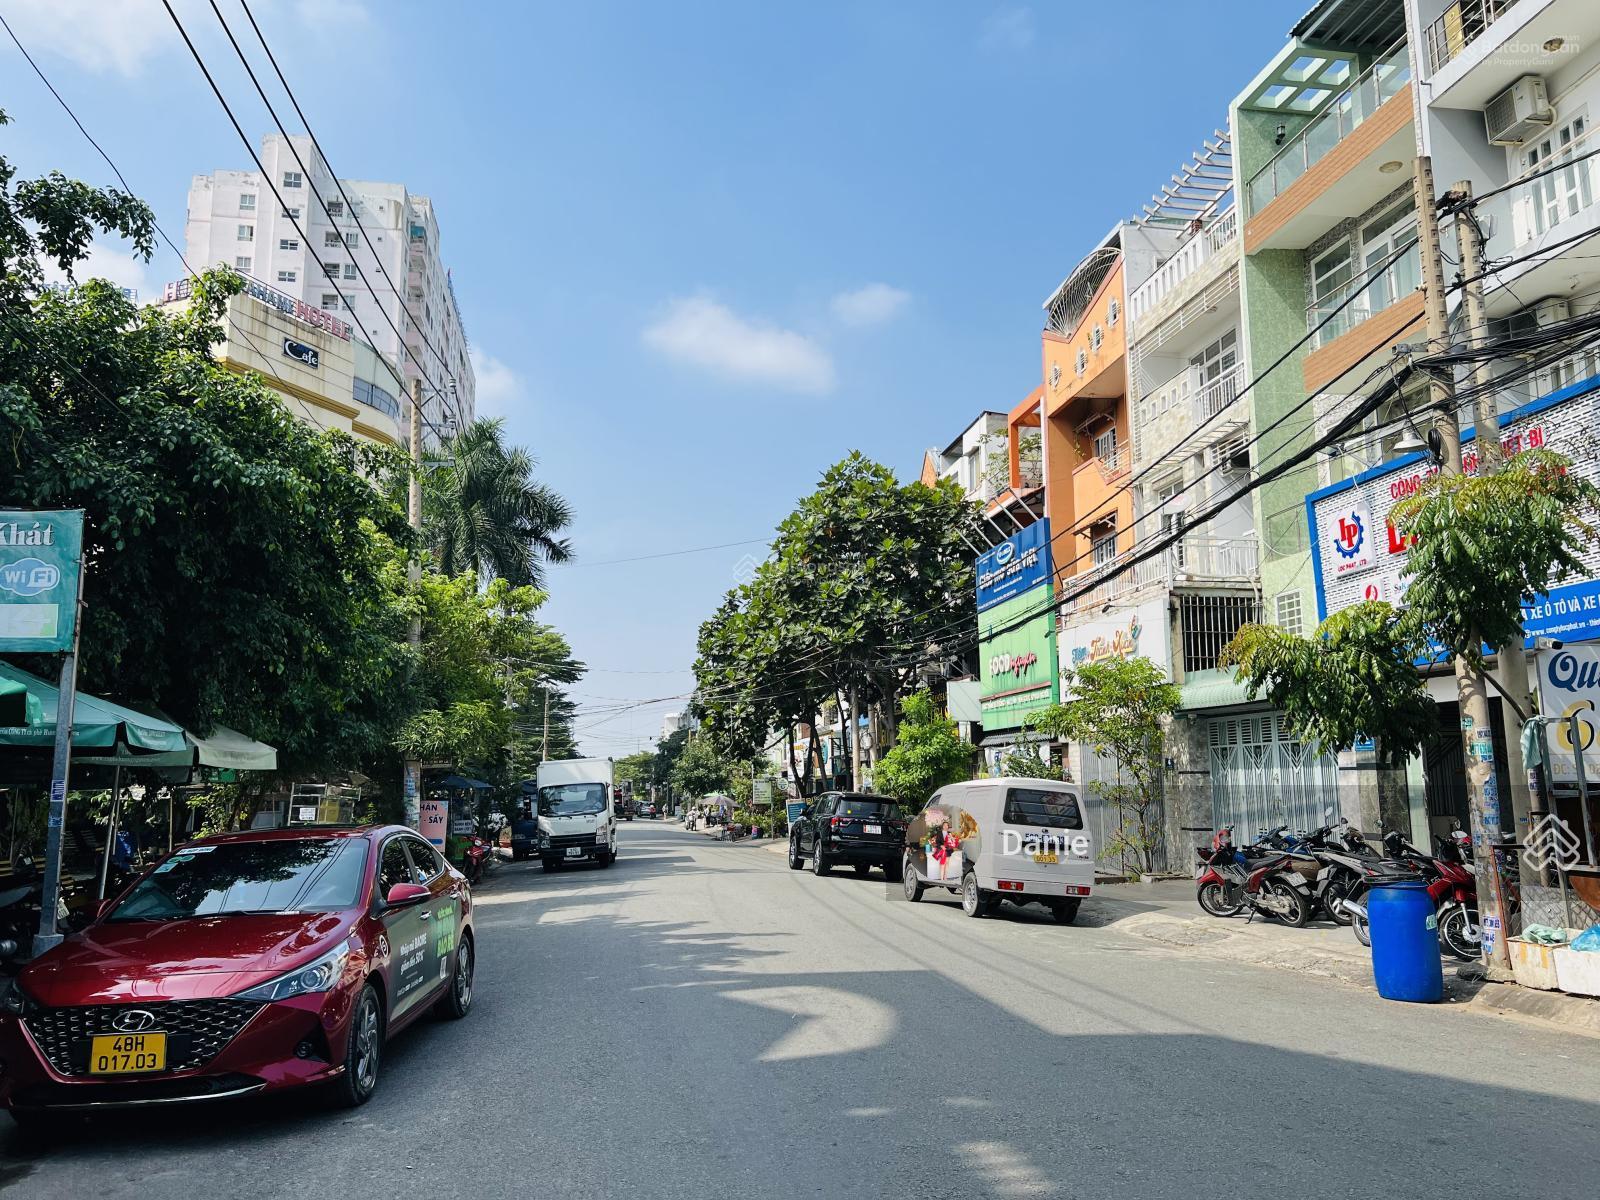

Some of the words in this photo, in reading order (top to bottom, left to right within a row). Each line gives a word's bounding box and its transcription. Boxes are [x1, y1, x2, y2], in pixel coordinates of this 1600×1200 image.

[284, 339, 319, 366] Cafe
[1530, 605, 1544, 620] XE
[1545, 601, 1552, 617] Ô
[1553, 598, 1567, 616] TÔ
[1567, 595, 1581, 613] VÀ
[1582, 595, 1597, 610] XE
[1548, 651, 1600, 693] Qu
[1556, 699, 1600, 752] 6
[113, 1035, 145, 1053] 48H
[98, 1053, 157, 1072] 017.03
